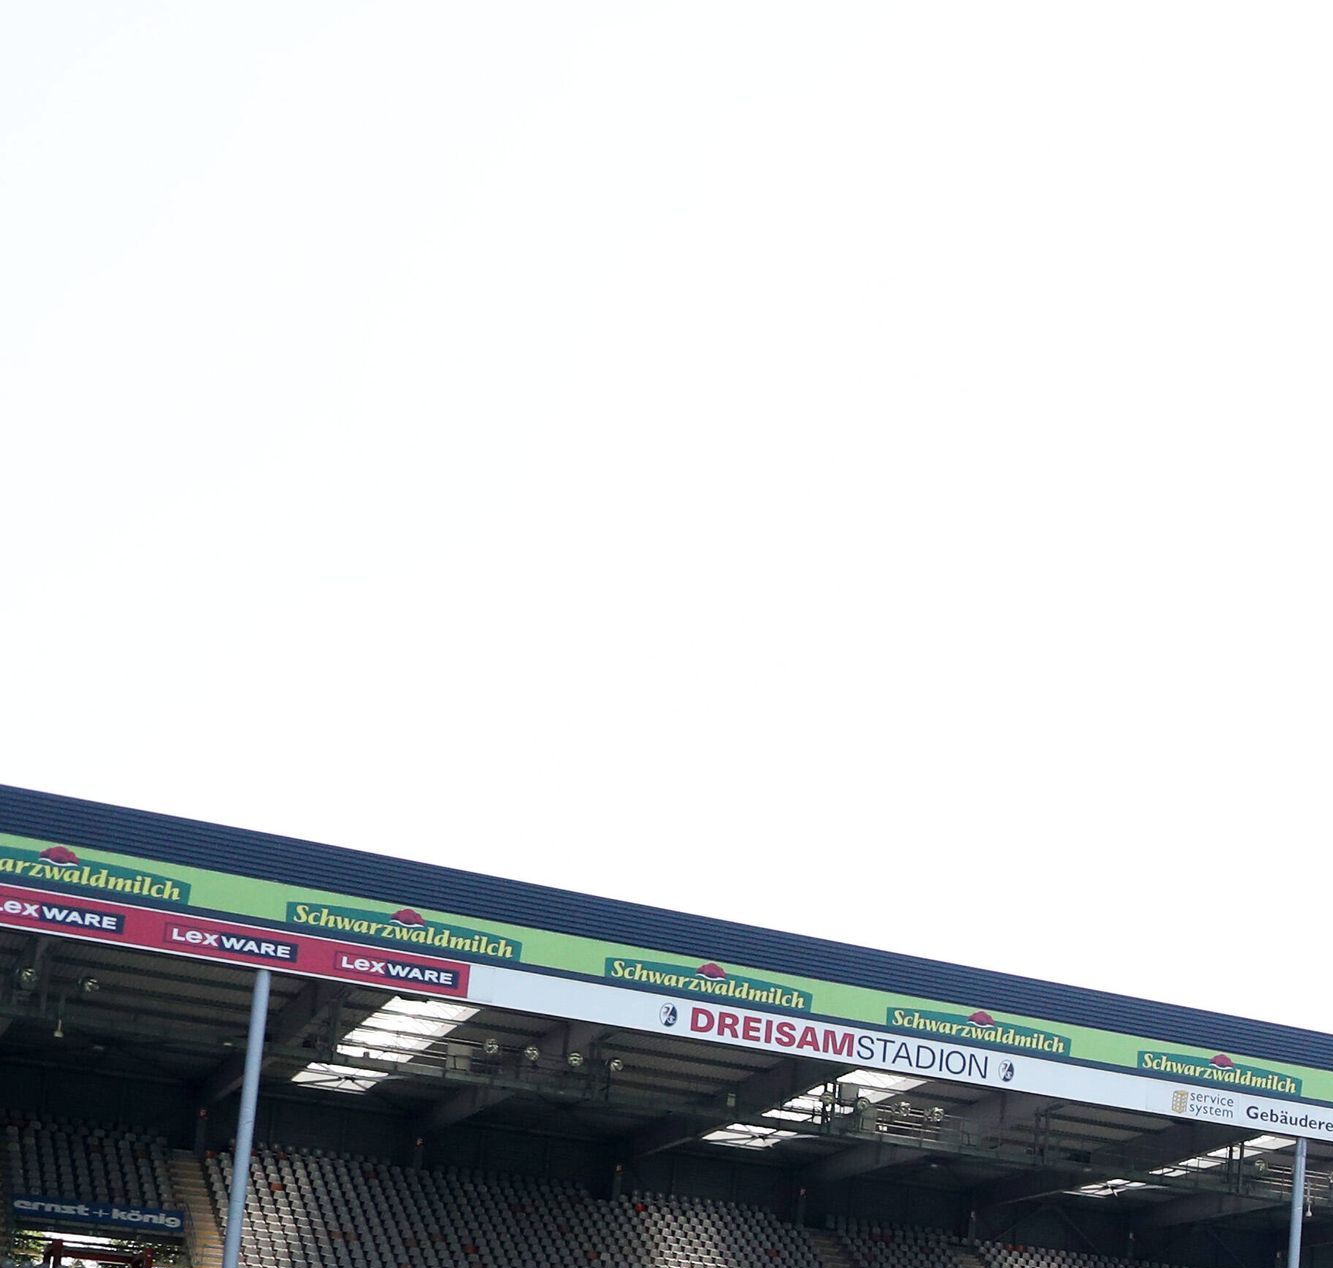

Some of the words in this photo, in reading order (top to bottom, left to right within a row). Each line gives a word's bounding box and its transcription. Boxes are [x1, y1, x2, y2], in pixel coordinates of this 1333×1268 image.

[293, 905, 513, 959] Schwarzwaldmilch
[611, 960, 805, 1009] Schwarzwaldmilch
[689, 1007, 988, 1079] DREISAMSTADION
[892, 1009, 1065, 1053] Schwarzwaldmilch
[1142, 1052, 1296, 1094] Schwarzwaldmilch
[1189, 1103, 1234, 1119] system
[1190, 1091, 1234, 1107] service
[13, 1200, 90, 1217] ernst
[111, 1208, 182, 1229] könig
